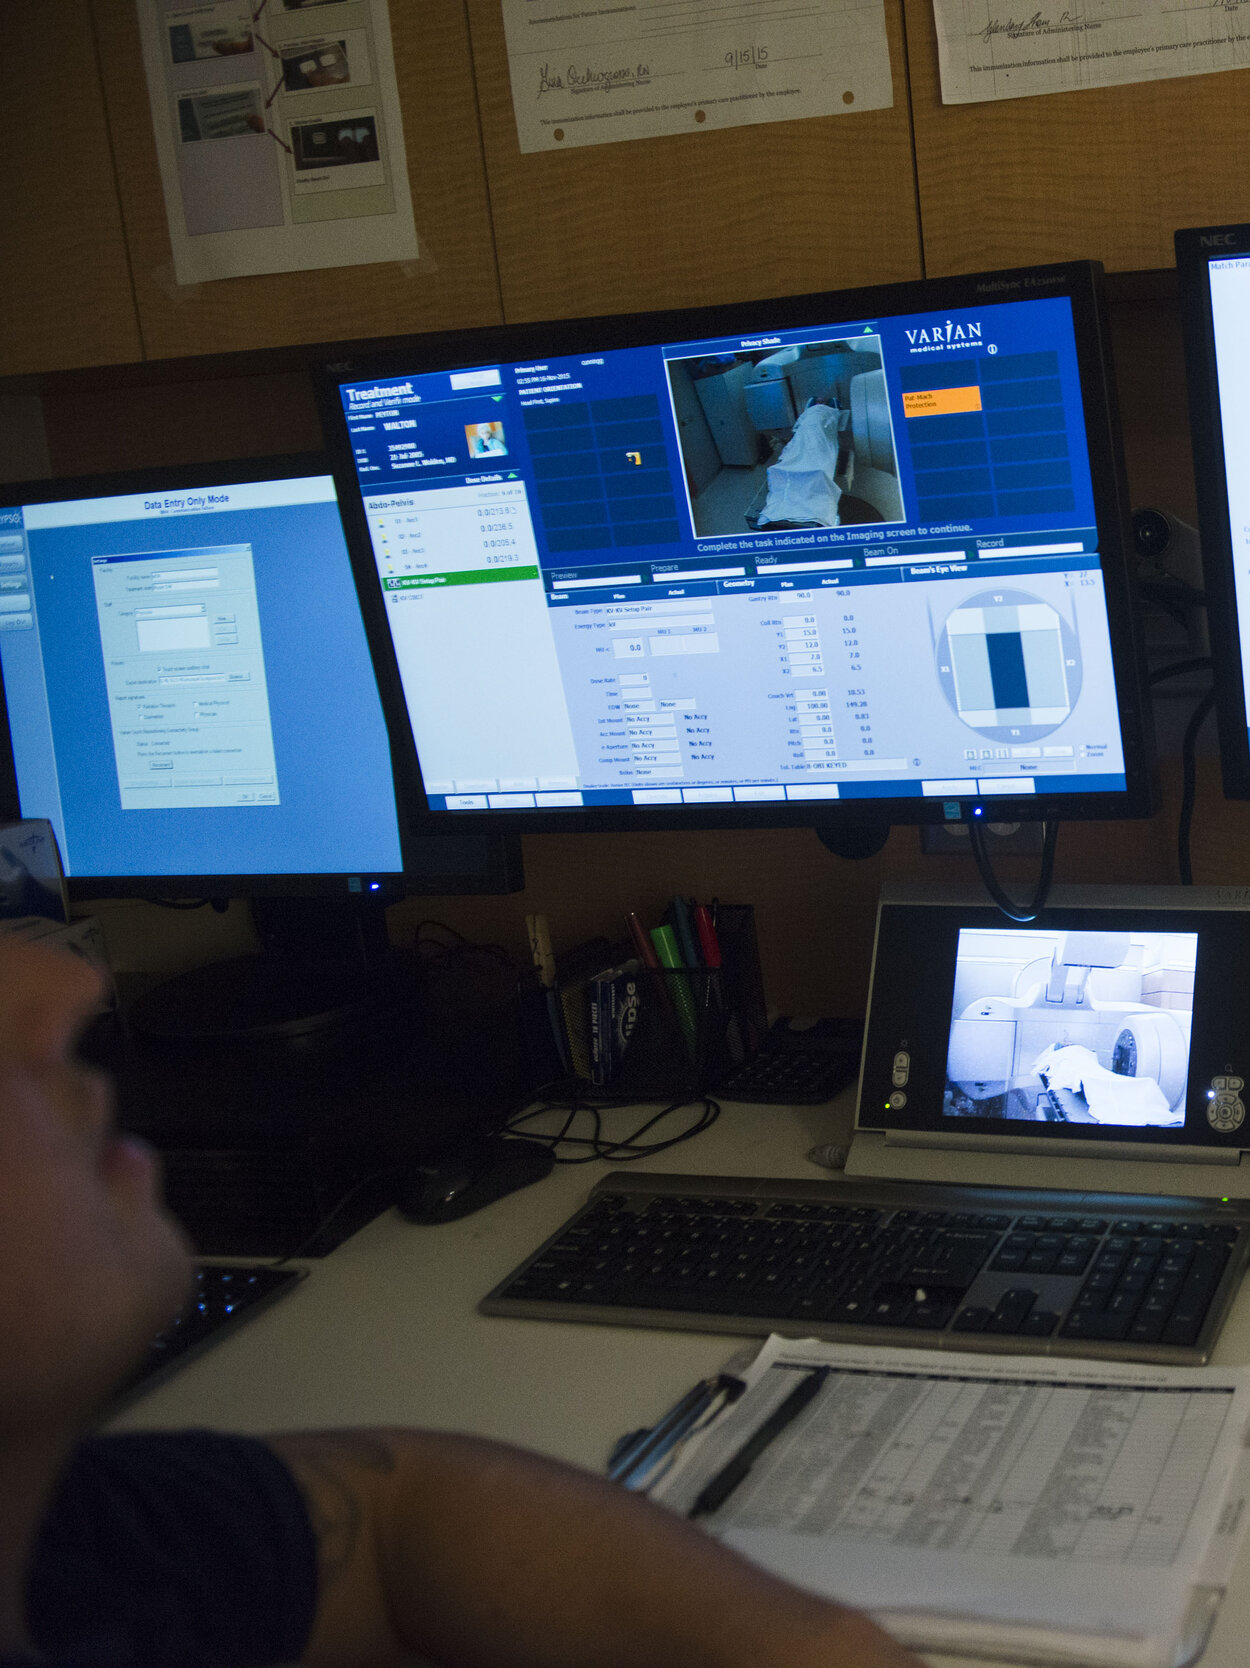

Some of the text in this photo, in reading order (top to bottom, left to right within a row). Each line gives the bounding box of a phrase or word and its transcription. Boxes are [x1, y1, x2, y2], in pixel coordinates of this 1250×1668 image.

[1224, 4, 1239, 12] Date
[724, 45, 769, 71] 9/15/15
[982, 61, 1023, 71] immunization
[1022, 57, 1056, 68] information
[1056, 55, 1070, 64] shall
[1079, 50, 1106, 62] provided
[1113, 49, 1123, 57] the
[1123, 45, 1155, 57] employee's
[1155, 43, 1179, 54] primary
[1179, 41, 1192, 49] care
[1192, 38, 1227, 50] practitioner
[1200, 232, 1237, 248] NEC
[1210, 262, 1234, 271] Match
[904, 320, 982, 345] VARIAN
[909, 341, 983, 354] medical systems
[345, 382, 415, 402] Treatment
[542, 381, 584, 393] ORIENTATION
[349, 400, 371, 411] Record
[370, 400, 383, 408] and
[144, 500, 163, 511] Data
[164, 498, 185, 510] Entry
[186, 496, 206, 508] Only
[207, 494, 230, 505] Mode
[368, 498, 414, 510] Abdo-Pelvis
[697, 523, 973, 554] Complete the task indicated on the Imaging screen to continue.
[976, 538, 1004, 549] Record
[863, 546, 899, 557] Beam On
[754, 556, 778, 568] Ready
[650, 564, 679, 575] Prepare
[949, 563, 968, 573] View
[551, 571, 578, 581] Preview
[722, 579, 755, 590] Geometry
[636, 715, 650, 724] Accy
[683, 713, 693, 721] No
[693, 713, 708, 722] Accy
[638, 728, 653, 737] Accy
[695, 726, 710, 735] Accy
[641, 741, 655, 750] Accy
[698, 739, 713, 748] Accy
[643, 754, 657, 763] Accy
[700, 752, 715, 761] Accy
